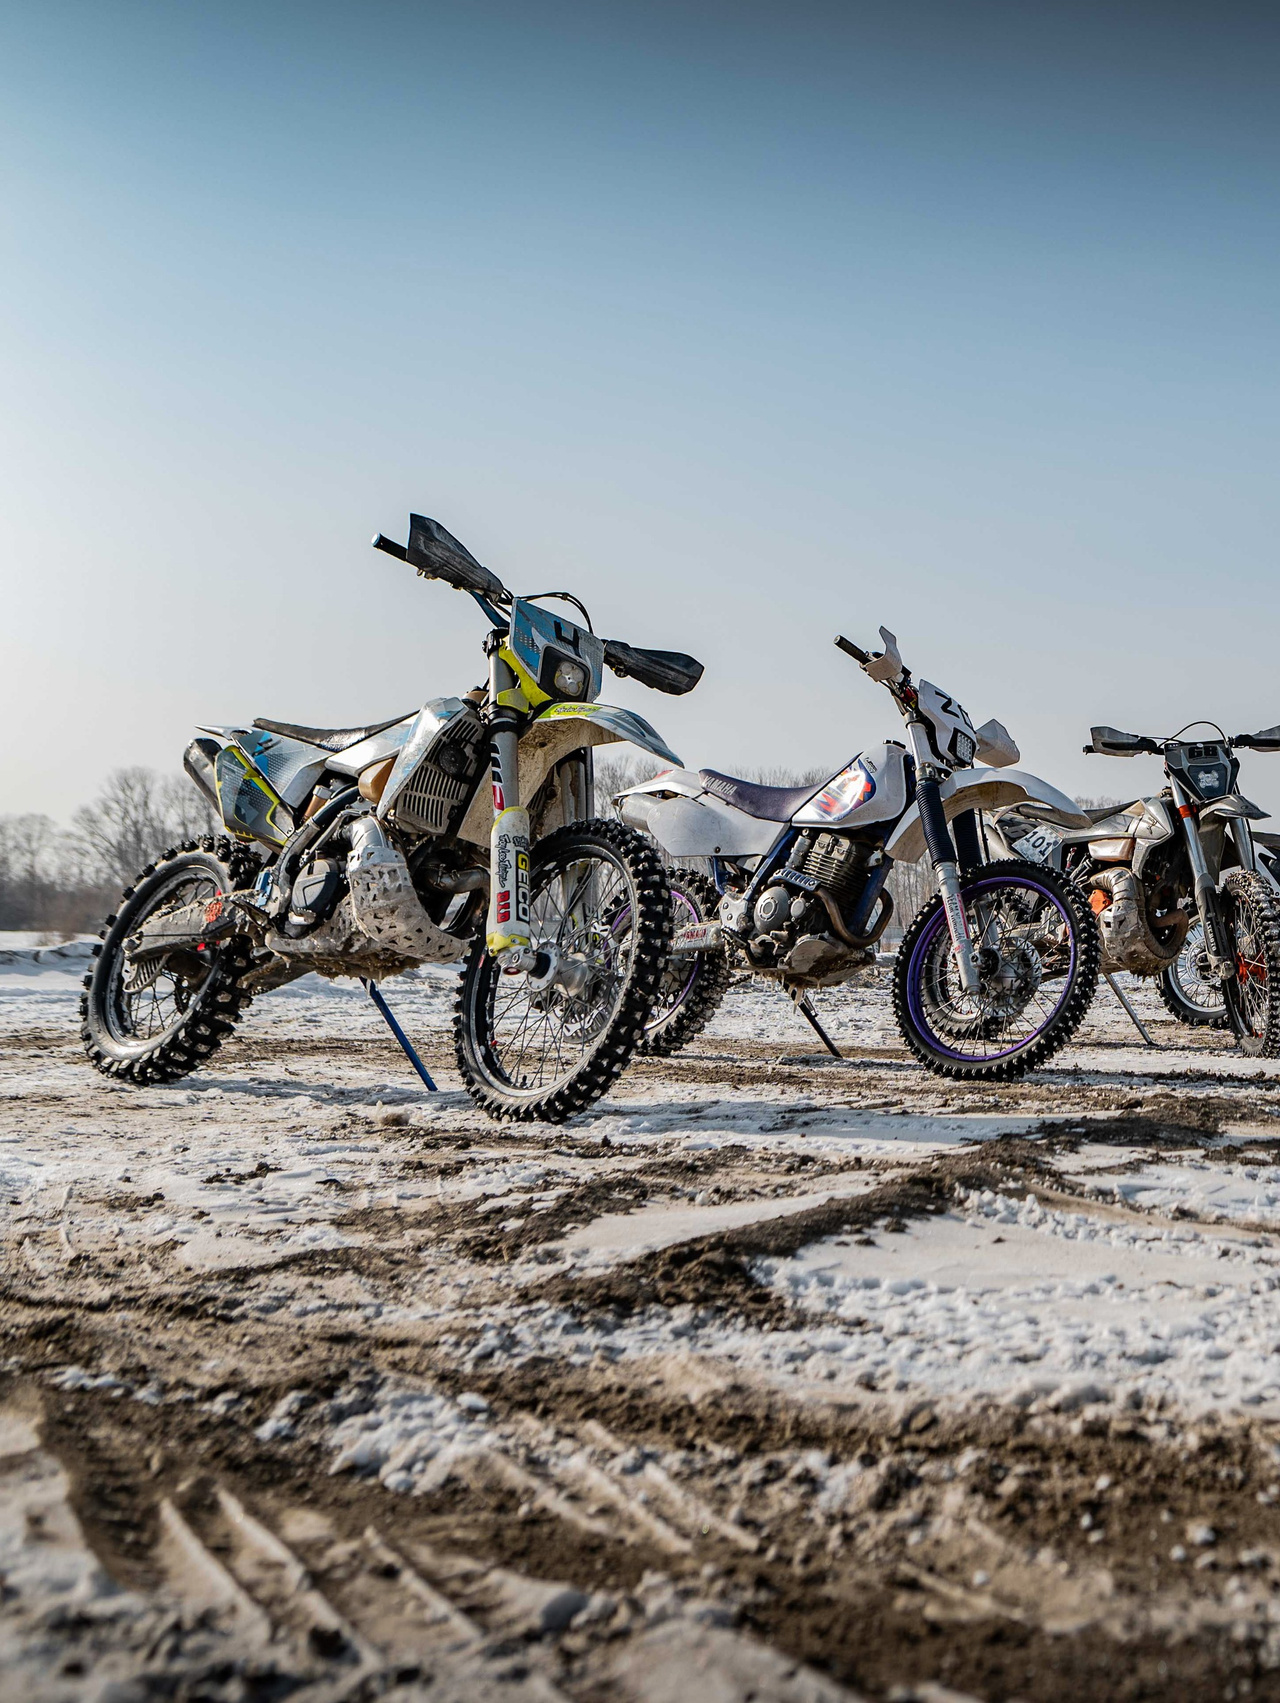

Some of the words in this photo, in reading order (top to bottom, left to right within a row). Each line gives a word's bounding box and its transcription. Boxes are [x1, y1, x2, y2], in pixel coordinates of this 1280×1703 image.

[702, 776, 738, 796] YAMAHA
[1024, 831, 1053, 857] 101
[517, 853, 530, 922] GEICO
